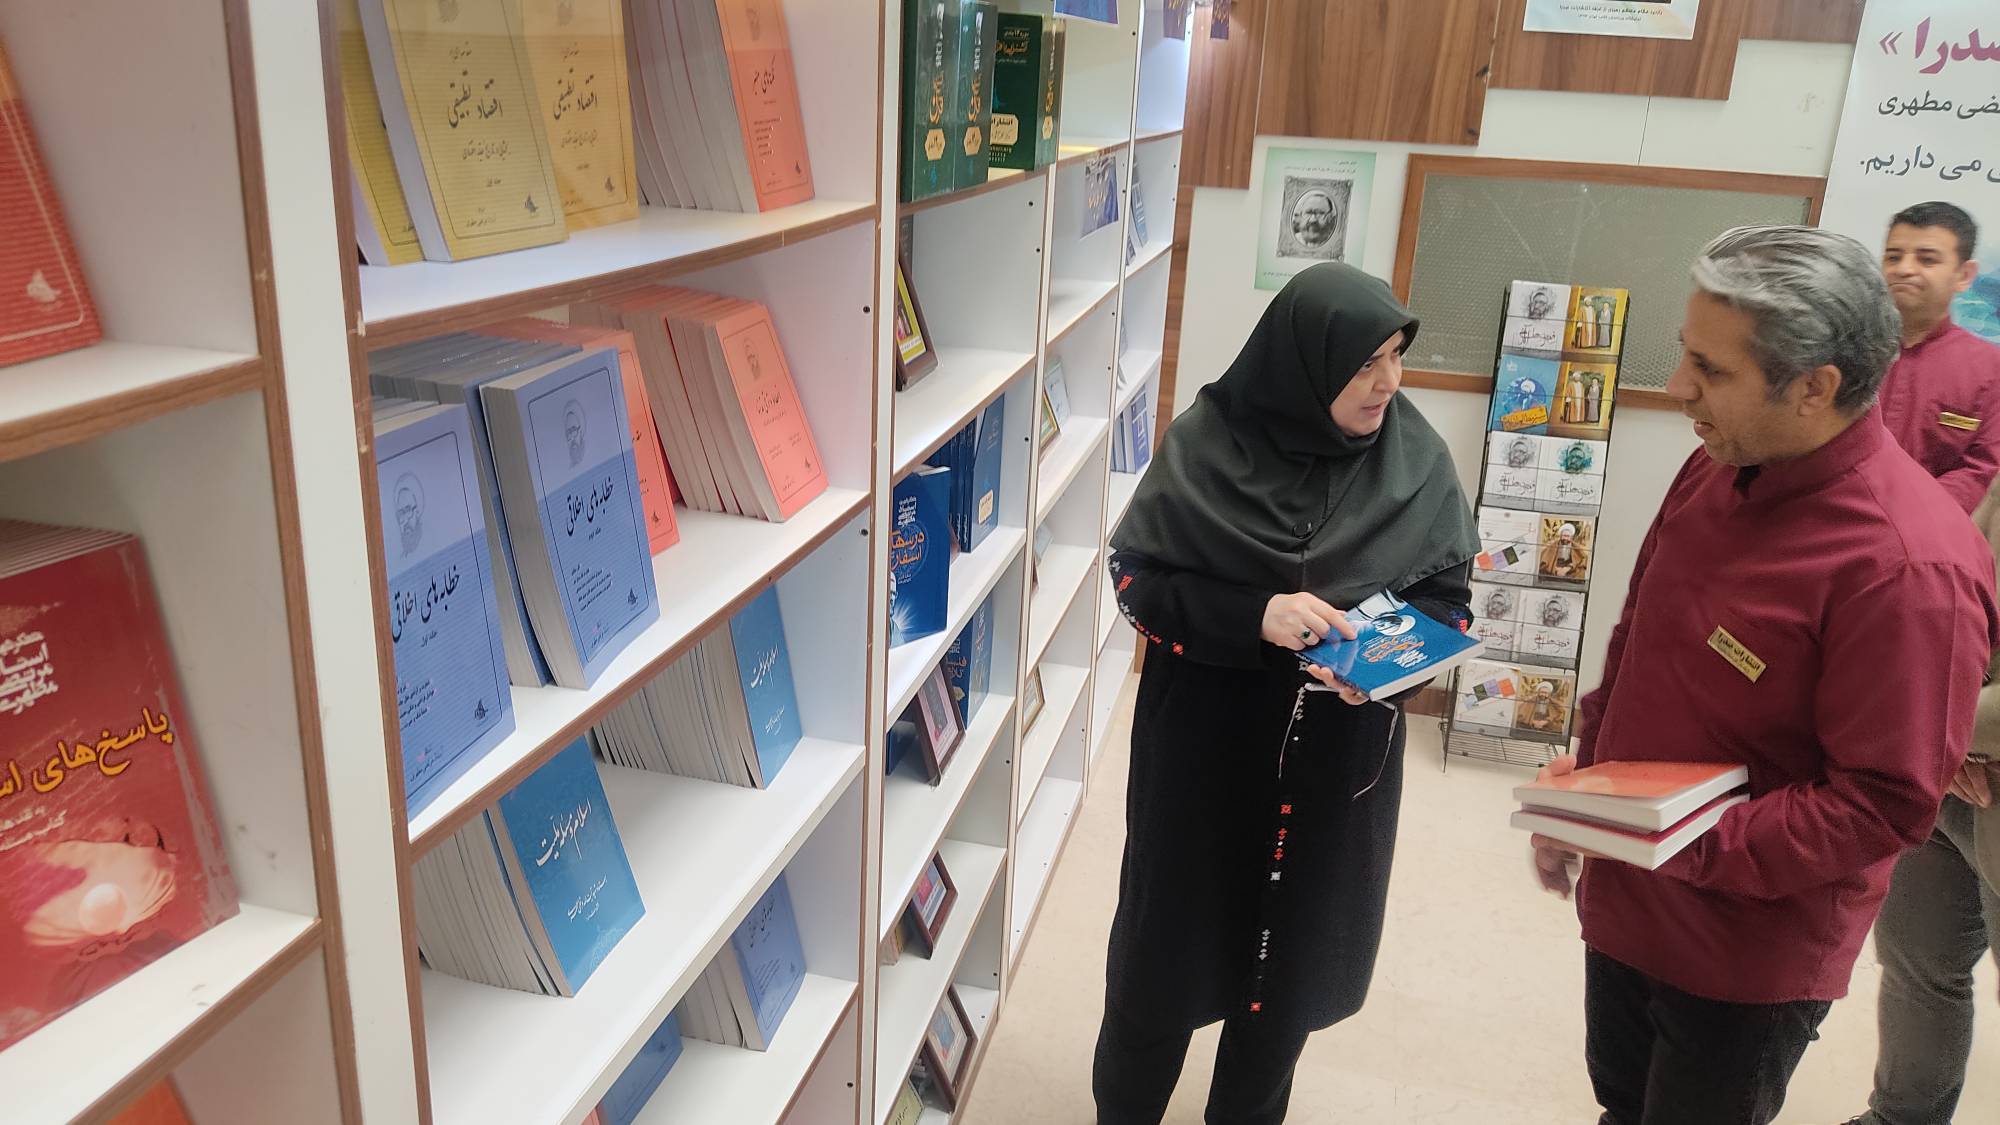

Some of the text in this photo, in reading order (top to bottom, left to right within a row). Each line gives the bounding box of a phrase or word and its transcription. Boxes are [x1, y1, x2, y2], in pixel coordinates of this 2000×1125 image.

[477, 78, 503, 119] اقتصاد
[1878, 90, 1953, 116] مطهری
[1939, 159, 1982, 180] می
[567, 493, 585, 537] اخلاقی
[0, 642, 49, 676] استا
[573, 797, 592, 861] اسلام
